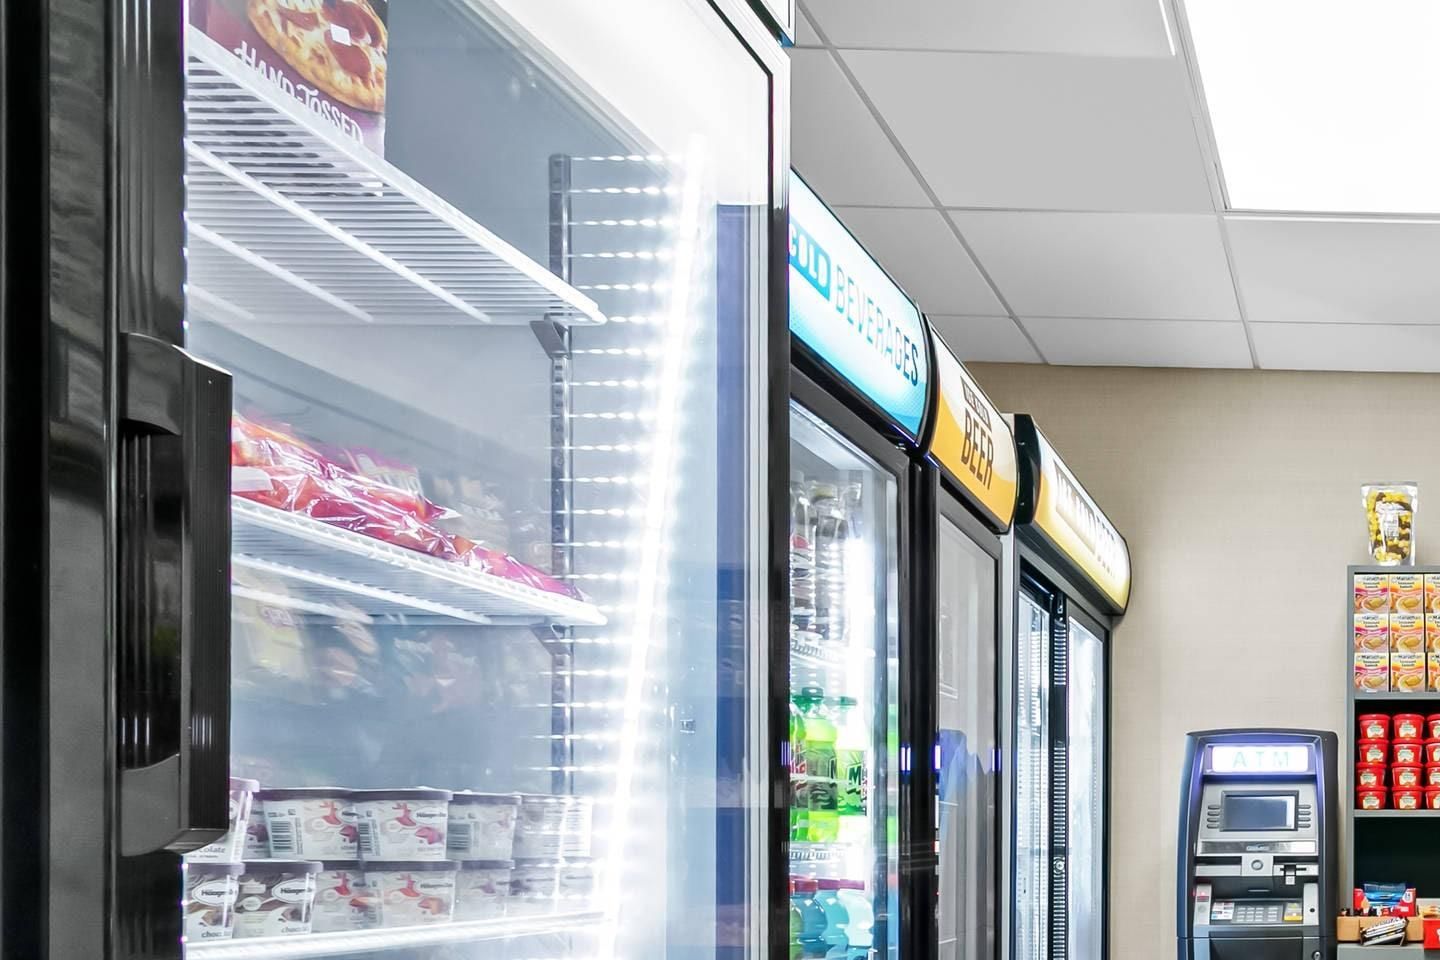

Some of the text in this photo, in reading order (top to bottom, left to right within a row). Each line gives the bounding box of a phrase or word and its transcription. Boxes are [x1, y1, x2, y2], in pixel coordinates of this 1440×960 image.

[835, 264, 920, 387] BEVERAGES
[961, 407, 994, 490] BEER
[1233, 751, 1290, 768] ATM
